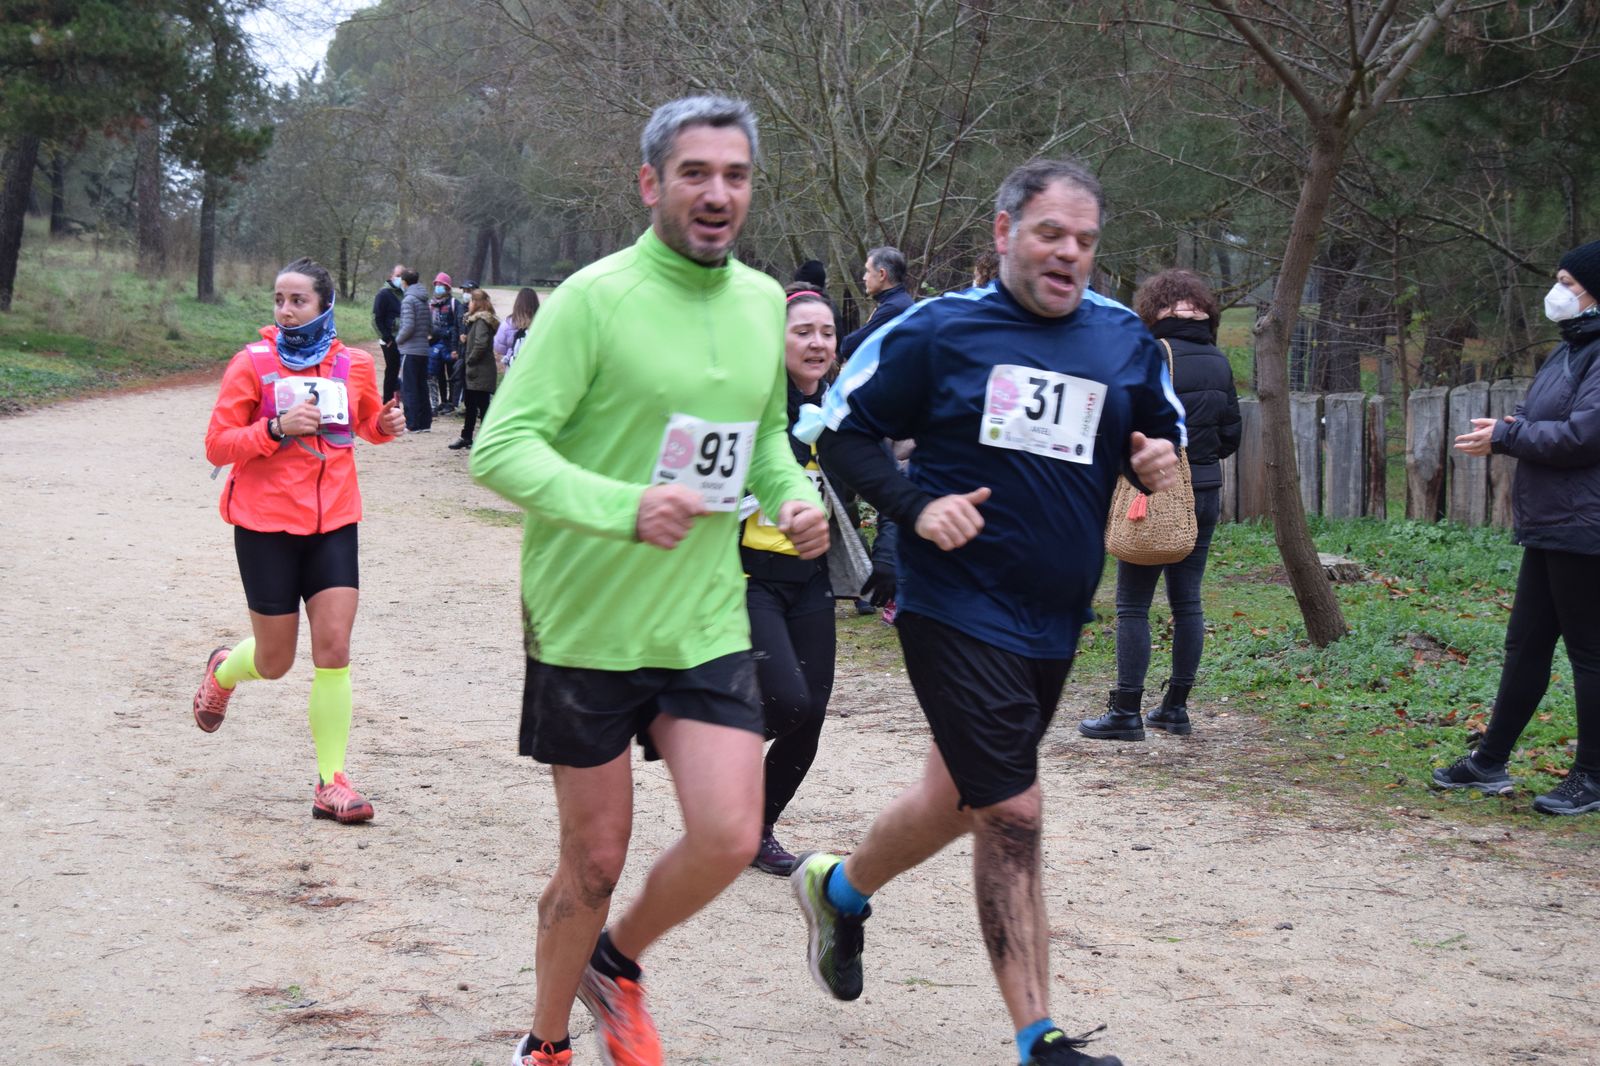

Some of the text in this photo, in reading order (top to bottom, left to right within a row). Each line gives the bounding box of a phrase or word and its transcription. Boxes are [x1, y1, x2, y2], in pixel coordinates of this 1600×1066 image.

[304, 382, 319, 406] 3
[1025, 376, 1066, 425] 31
[695, 432, 740, 478] 93
